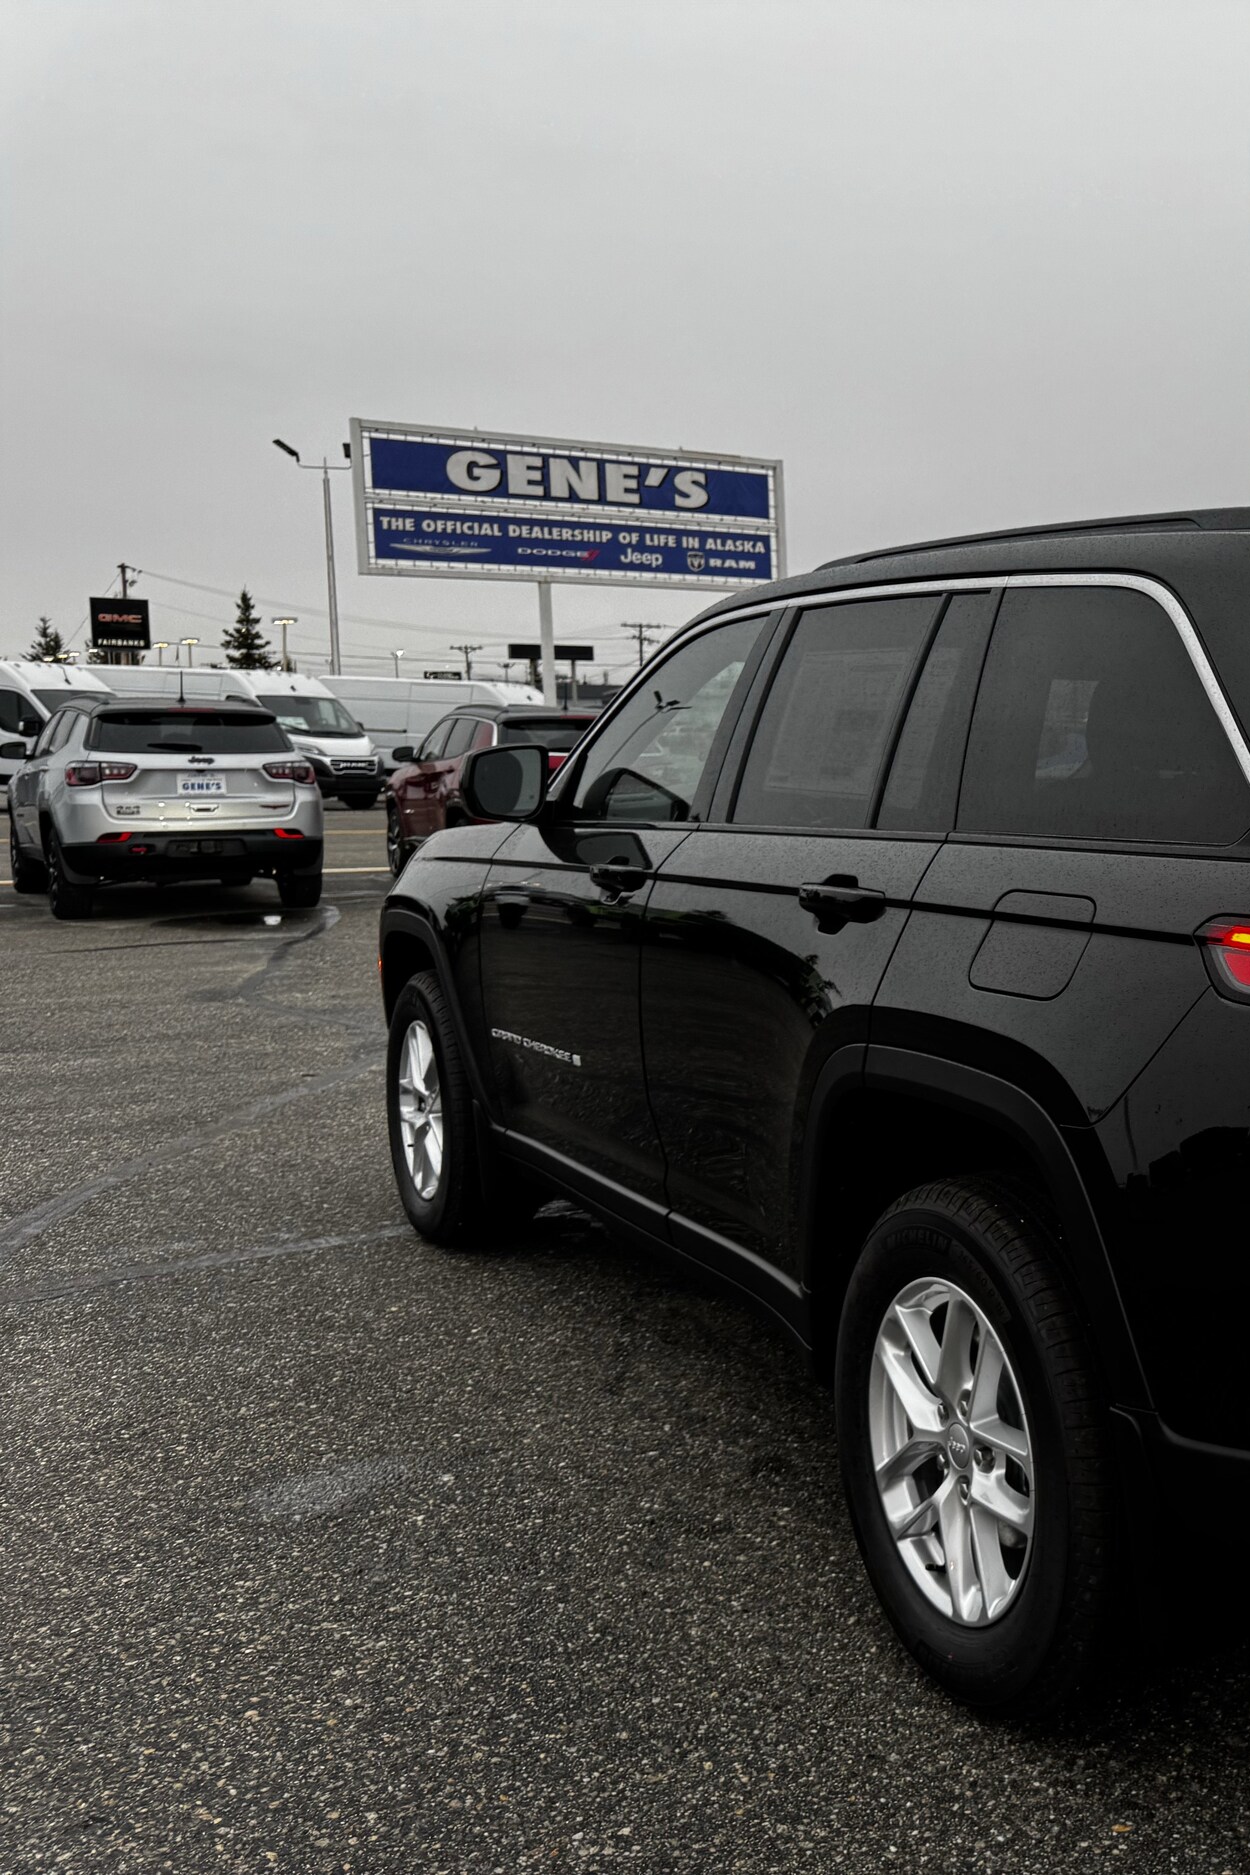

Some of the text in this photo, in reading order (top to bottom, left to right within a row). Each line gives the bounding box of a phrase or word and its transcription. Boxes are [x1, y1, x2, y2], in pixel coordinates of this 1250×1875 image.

[446, 450, 710, 509] GENE'S
[379, 516, 765, 553] THE OFFICIAL DEALERSHIP OF LIFE IN ALASKA
[403, 537, 479, 547] CHRYSLER
[517, 547, 588, 558] DODGE
[620, 547, 663, 567] Jeep
[709, 558, 756, 569] RAM
[98, 613, 142, 623] GMC
[98, 638, 145, 647] FAIRBANKS
[182, 782, 222, 791] GENE'S
